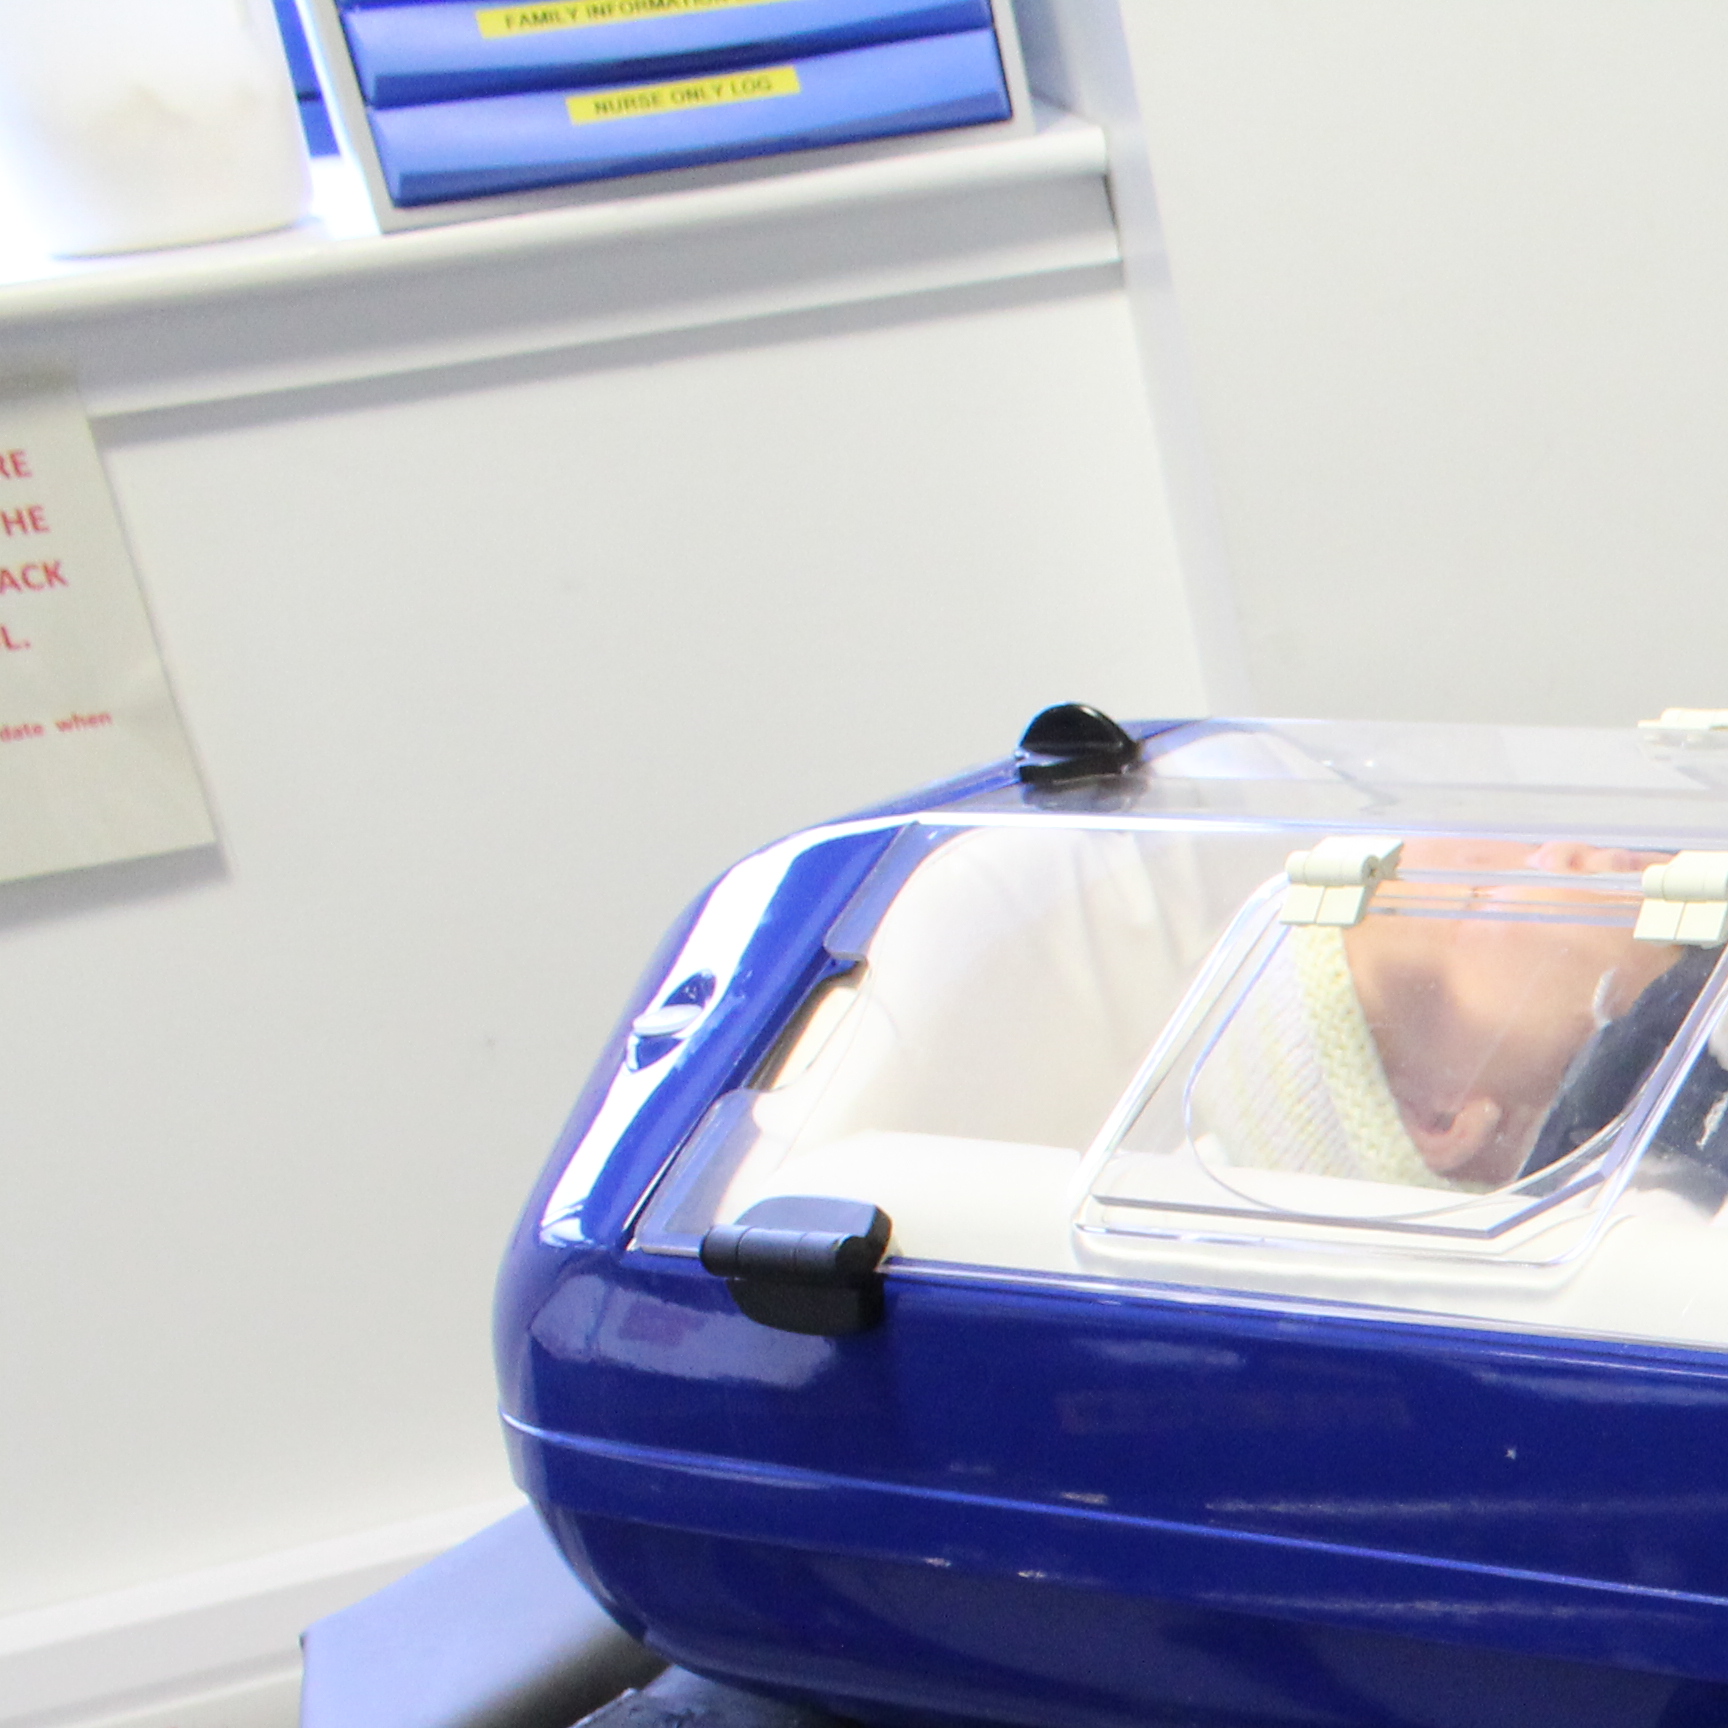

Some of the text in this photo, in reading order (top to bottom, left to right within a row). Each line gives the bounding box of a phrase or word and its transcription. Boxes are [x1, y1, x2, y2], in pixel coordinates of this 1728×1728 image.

[504, 7, 578, 30] FAMILY
[594, 75, 773, 117] NURSE ONLY LOG
[55, 712, 112, 732] when
